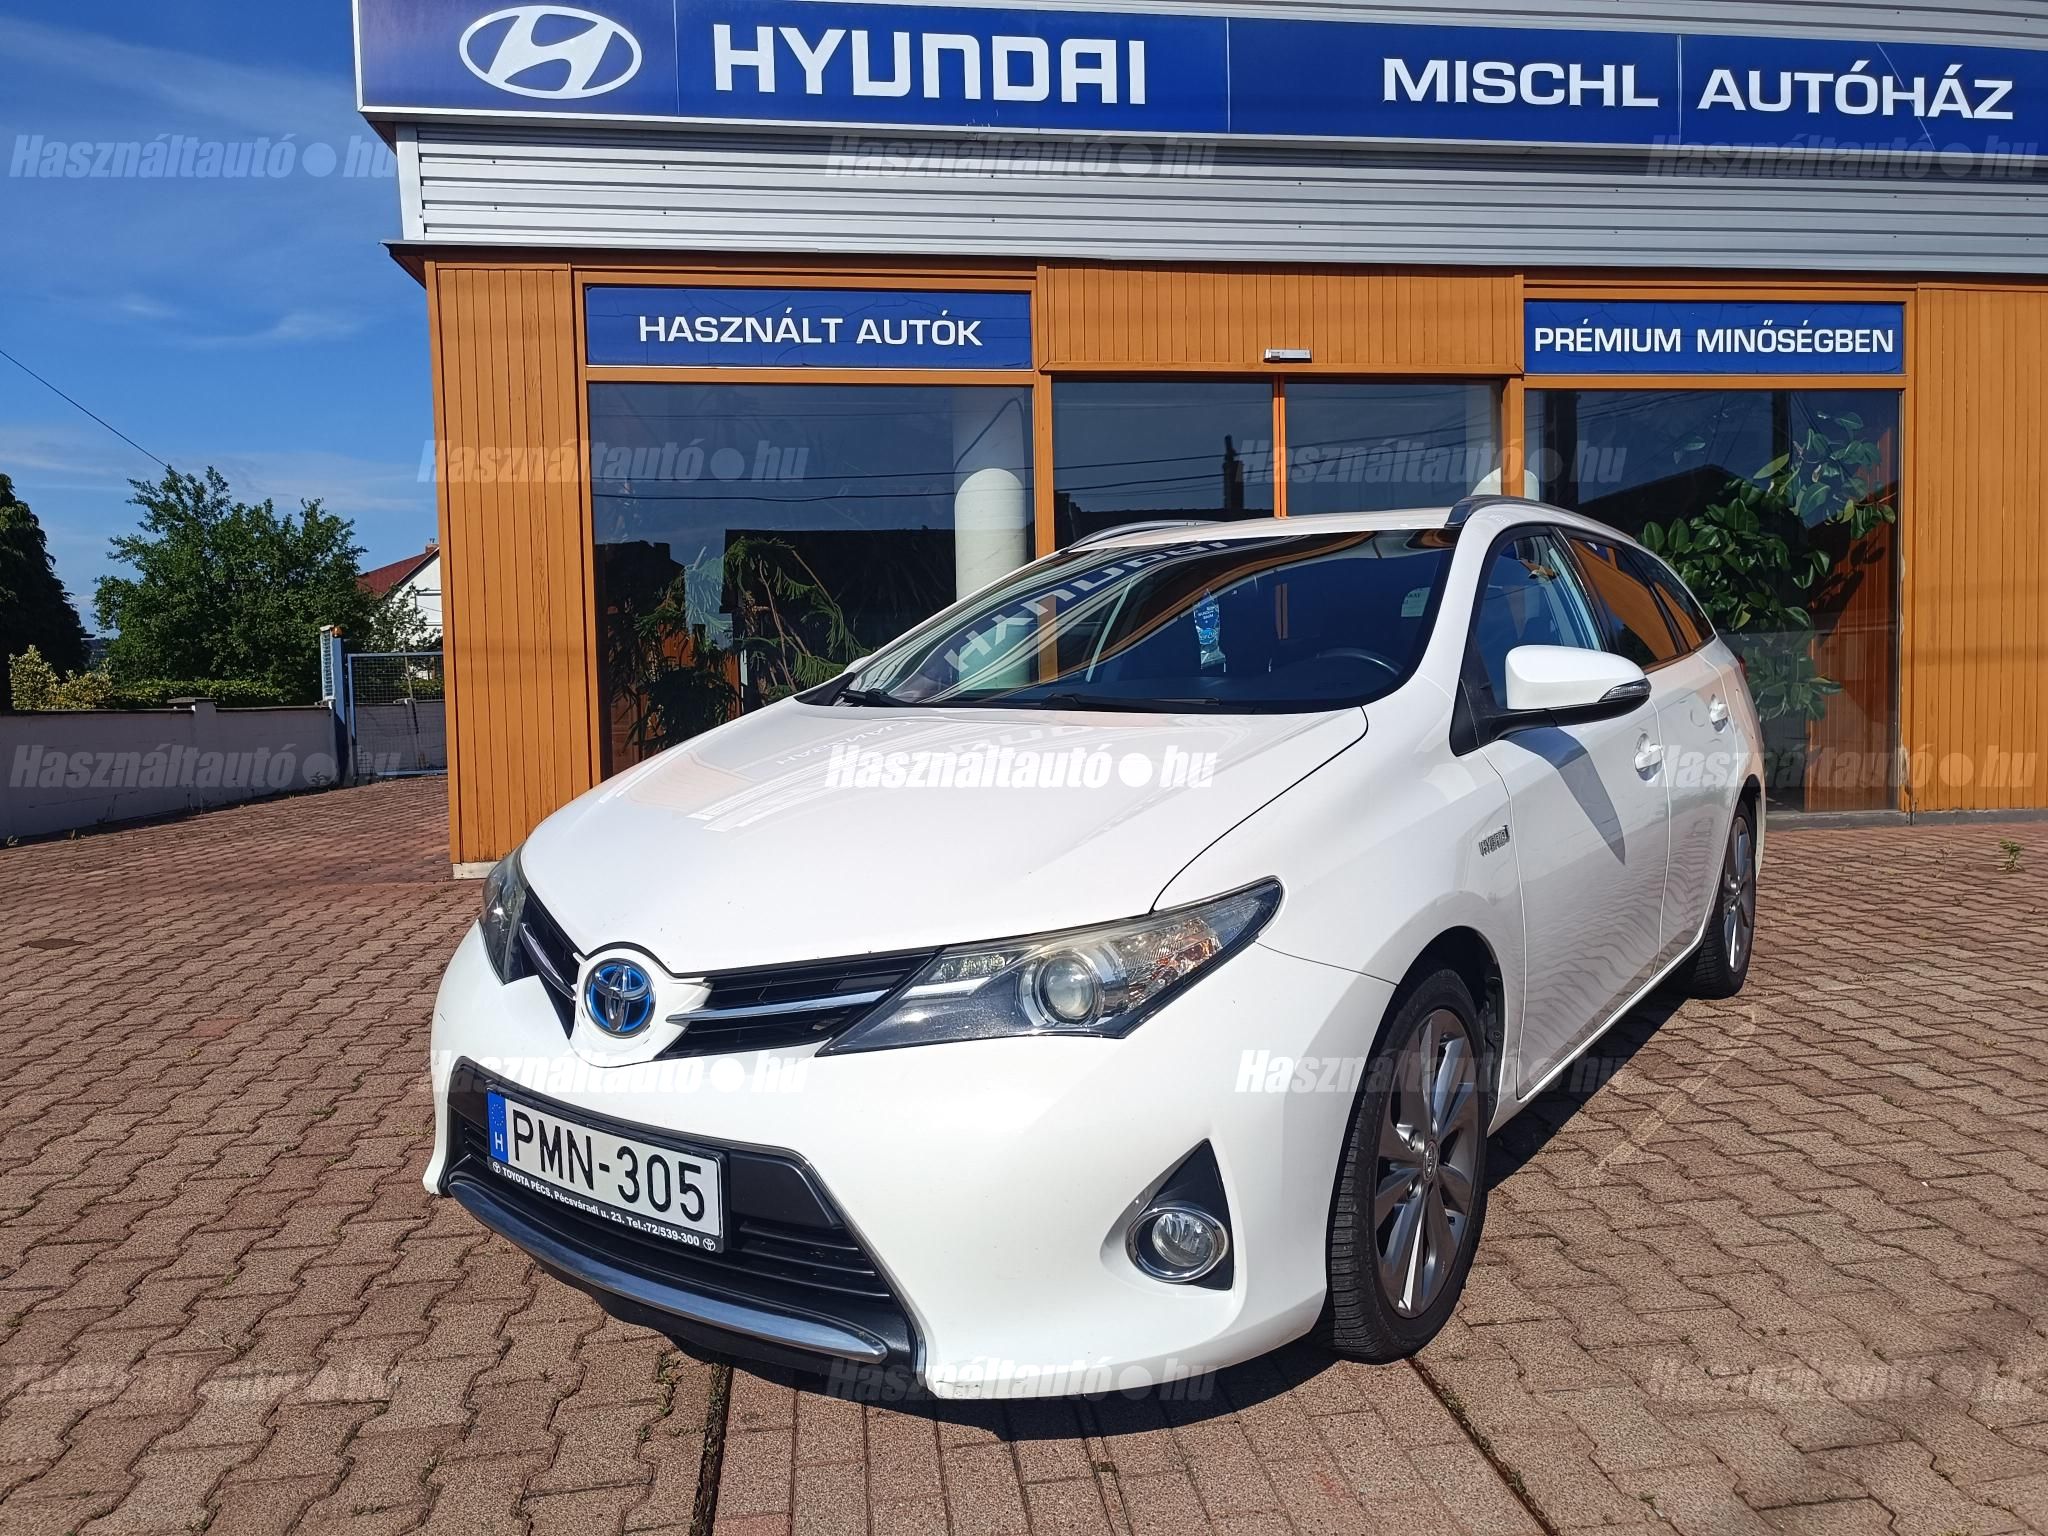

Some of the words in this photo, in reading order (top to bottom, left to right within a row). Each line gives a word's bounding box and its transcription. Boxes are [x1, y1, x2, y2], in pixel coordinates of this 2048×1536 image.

[713, 24, 1147, 106] HYUNDAI
[1383, 57, 1659, 108] MISCHL
[1697, 59, 2014, 121] AUTÓHÁZ
[639, 307, 844, 346] HASZNÁLT
[856, 309, 983, 348] AUTÓK
[1534, 320, 1682, 353] PRÉMIUM
[1697, 320, 1894, 354] MINŐSÉGBEN
[494, 1131, 504, 1153] H
[512, 1108, 705, 1223] PMN-305
[502, 1167, 531, 1188] TOYOTA
[554, 1190, 600, 1216] Pécsváradi
